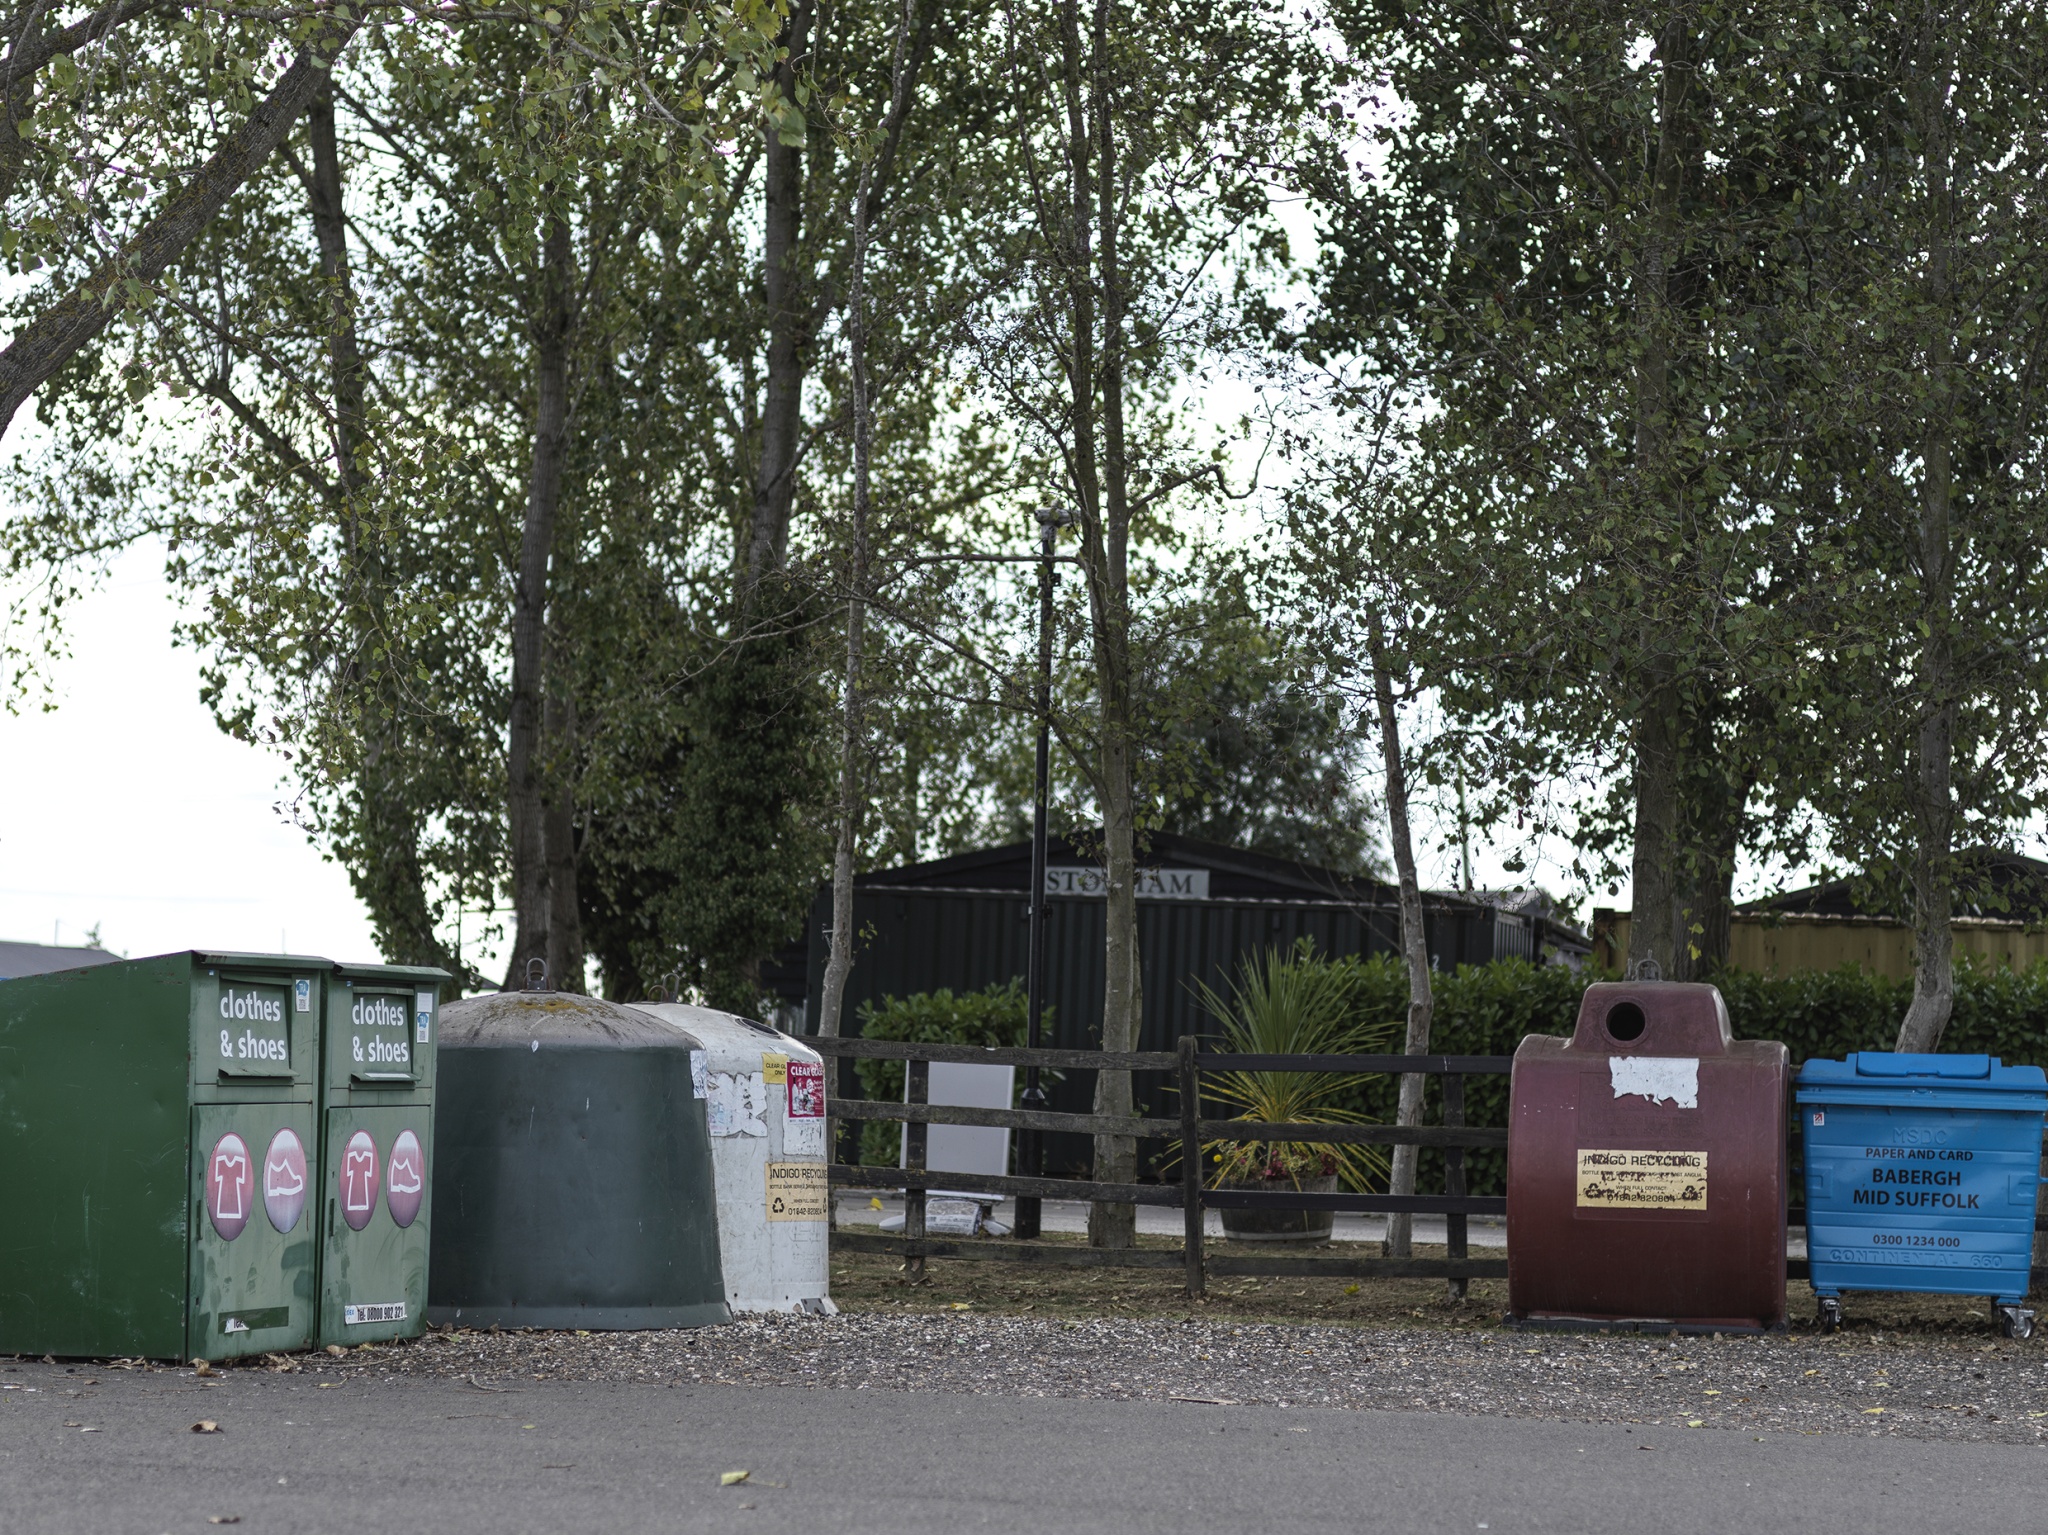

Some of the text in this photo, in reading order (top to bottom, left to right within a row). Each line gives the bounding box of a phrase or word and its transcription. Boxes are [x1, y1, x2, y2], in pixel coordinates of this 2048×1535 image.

[1046, 870, 1194, 895] STOAM
[220, 988, 281, 1022] clothes
[352, 997, 404, 1026] clothes
[220, 1029, 287, 1061] & shoes
[352, 1034, 409, 1063] & shoes
[790, 1065, 811, 1077] CLEAR
[1892, 1126, 1948, 1145] MSDC
[1583, 1155, 1701, 1167] INDIGO RECYCLING
[1865, 1147, 1974, 1162] PAPER AND CARD
[769, 1168, 800, 1179] INDIGO
[1872, 1168, 1961, 1187] BABERGH
[1853, 1189, 1980, 1210] MID SUFFOLK
[1872, 1234, 1961, 1248] 0300 1234 000
[1829, 1248, 2003, 1269] CONTINENTAL 660
[384, 1306, 394, 1320] 902
